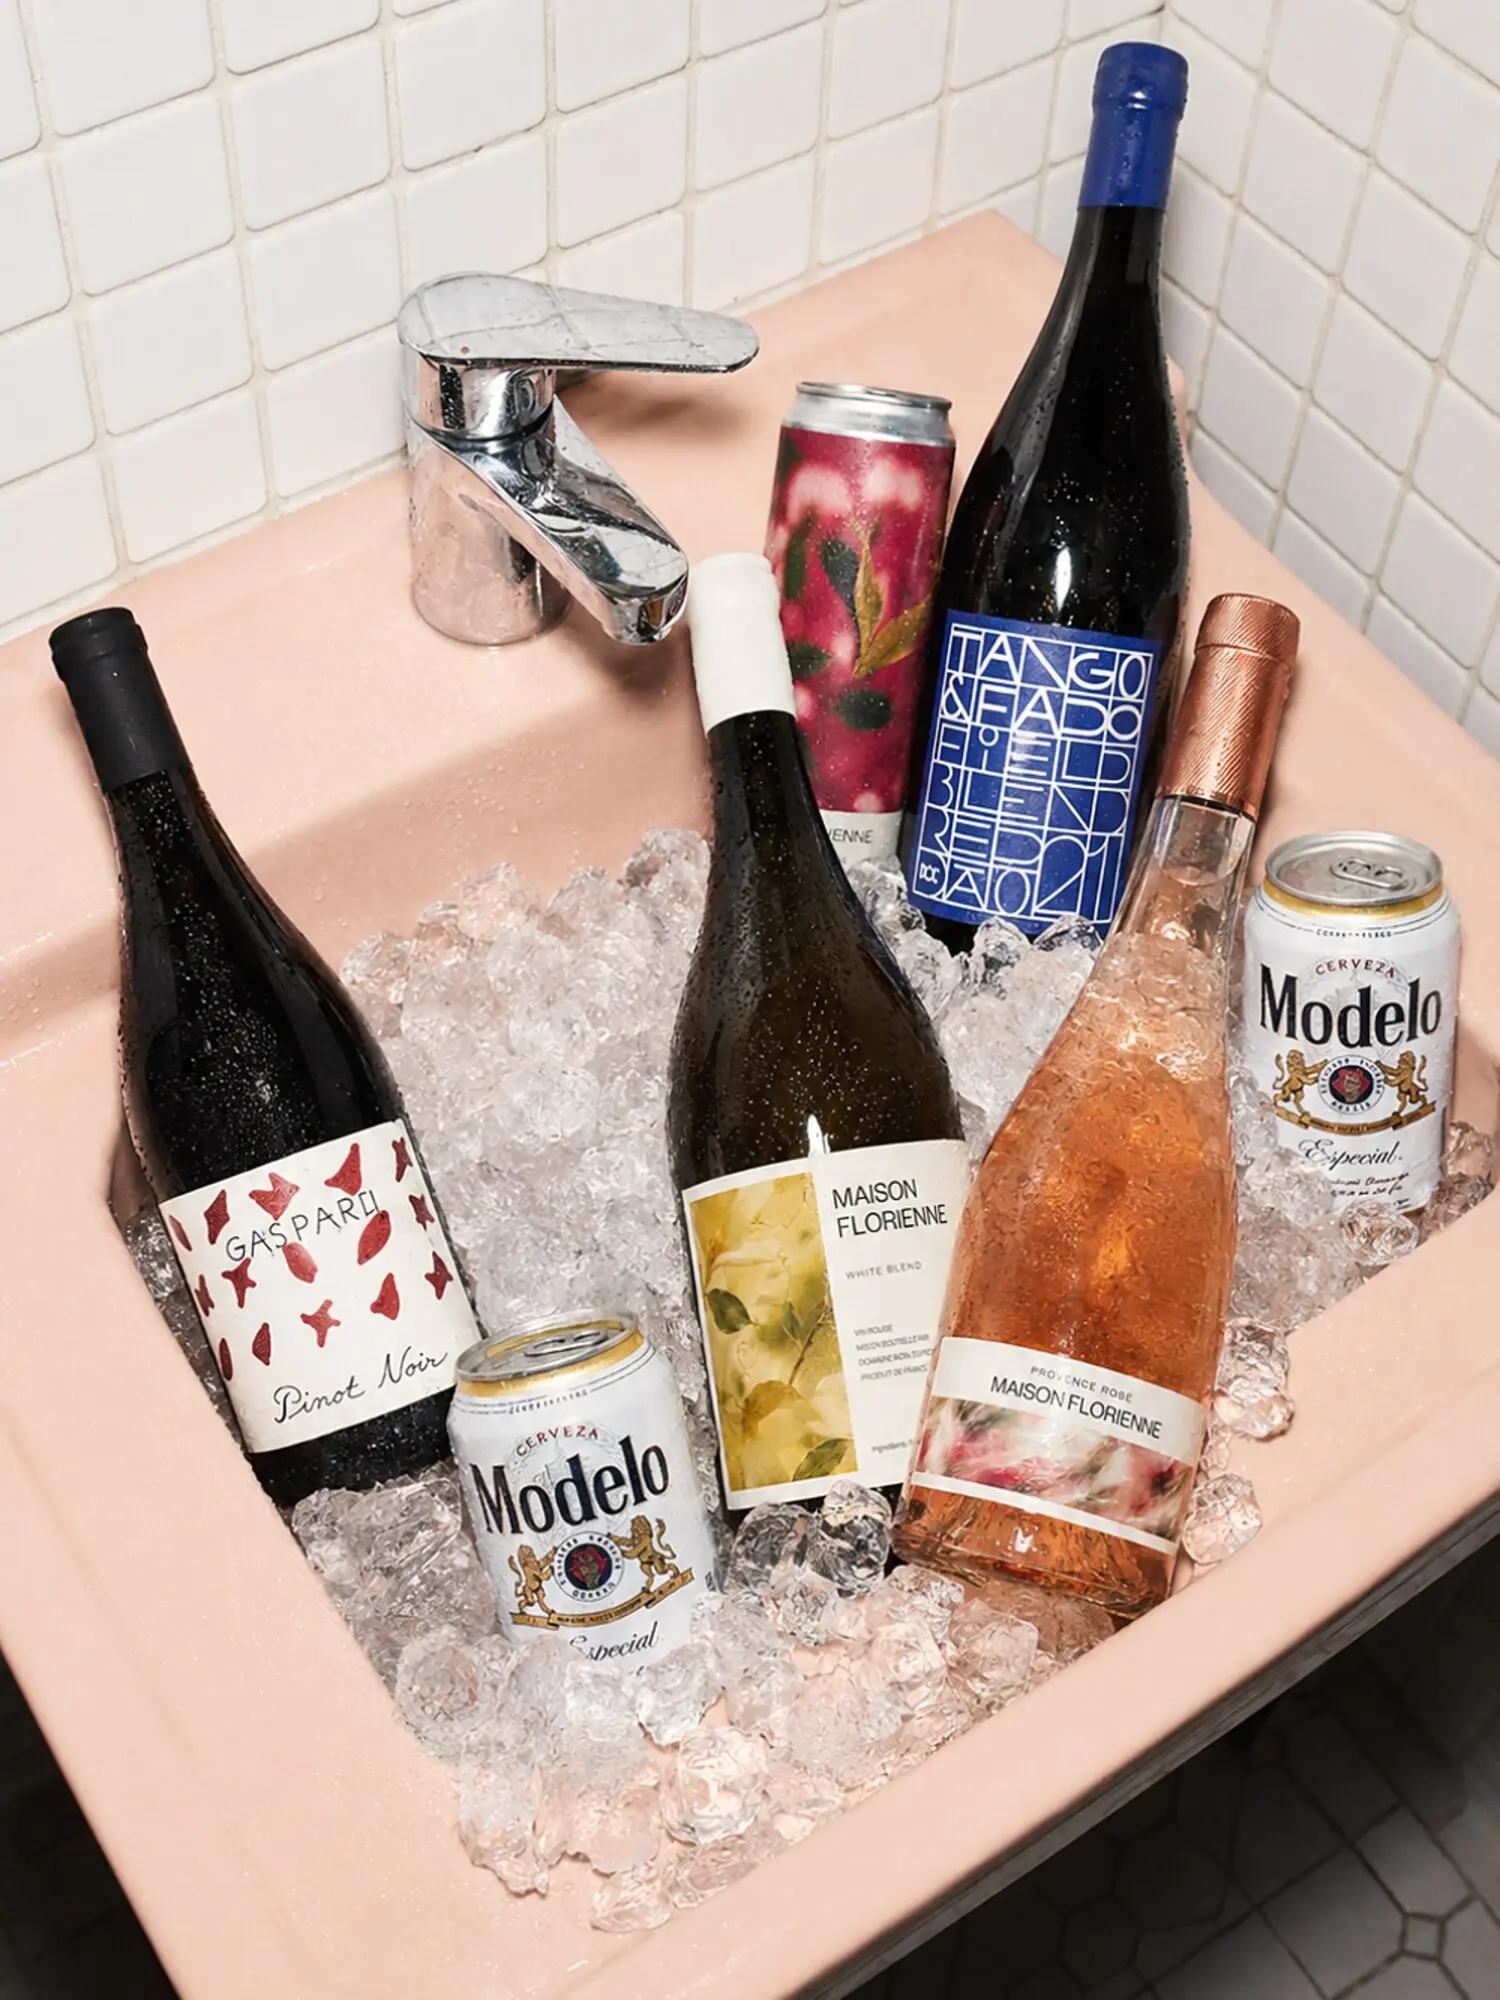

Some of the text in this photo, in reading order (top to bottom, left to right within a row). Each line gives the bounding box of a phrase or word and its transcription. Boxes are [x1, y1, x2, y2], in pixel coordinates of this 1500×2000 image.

[951, 631, 1146, 701] TANGO
[975, 683, 1142, 741] FADO
[935, 722, 1132, 786] FIELD
[926, 762, 1130, 836] BLEND
[919, 803, 1045, 866] RED
[1315, 958, 1396, 979] CERVEZA
[1259, 963, 1442, 1048] Modelo
[1298, 1138, 1401, 1171] Especial
[832, 1178, 918, 1210] MAISON
[837, 1203, 948, 1238] FLORIENNE
[225, 1189, 380, 1263] GASPARD
[844, 1260, 922, 1280] WHITE BLEND
[273, 1345, 449, 1425] Pinot Noir
[990, 1375, 1162, 1440] MAISON FLORIENNE
[1030, 1365, 1097, 1392] PROVENCE
[515, 1424, 599, 1457] CERVEZA
[469, 1434, 670, 1536] Modelo
